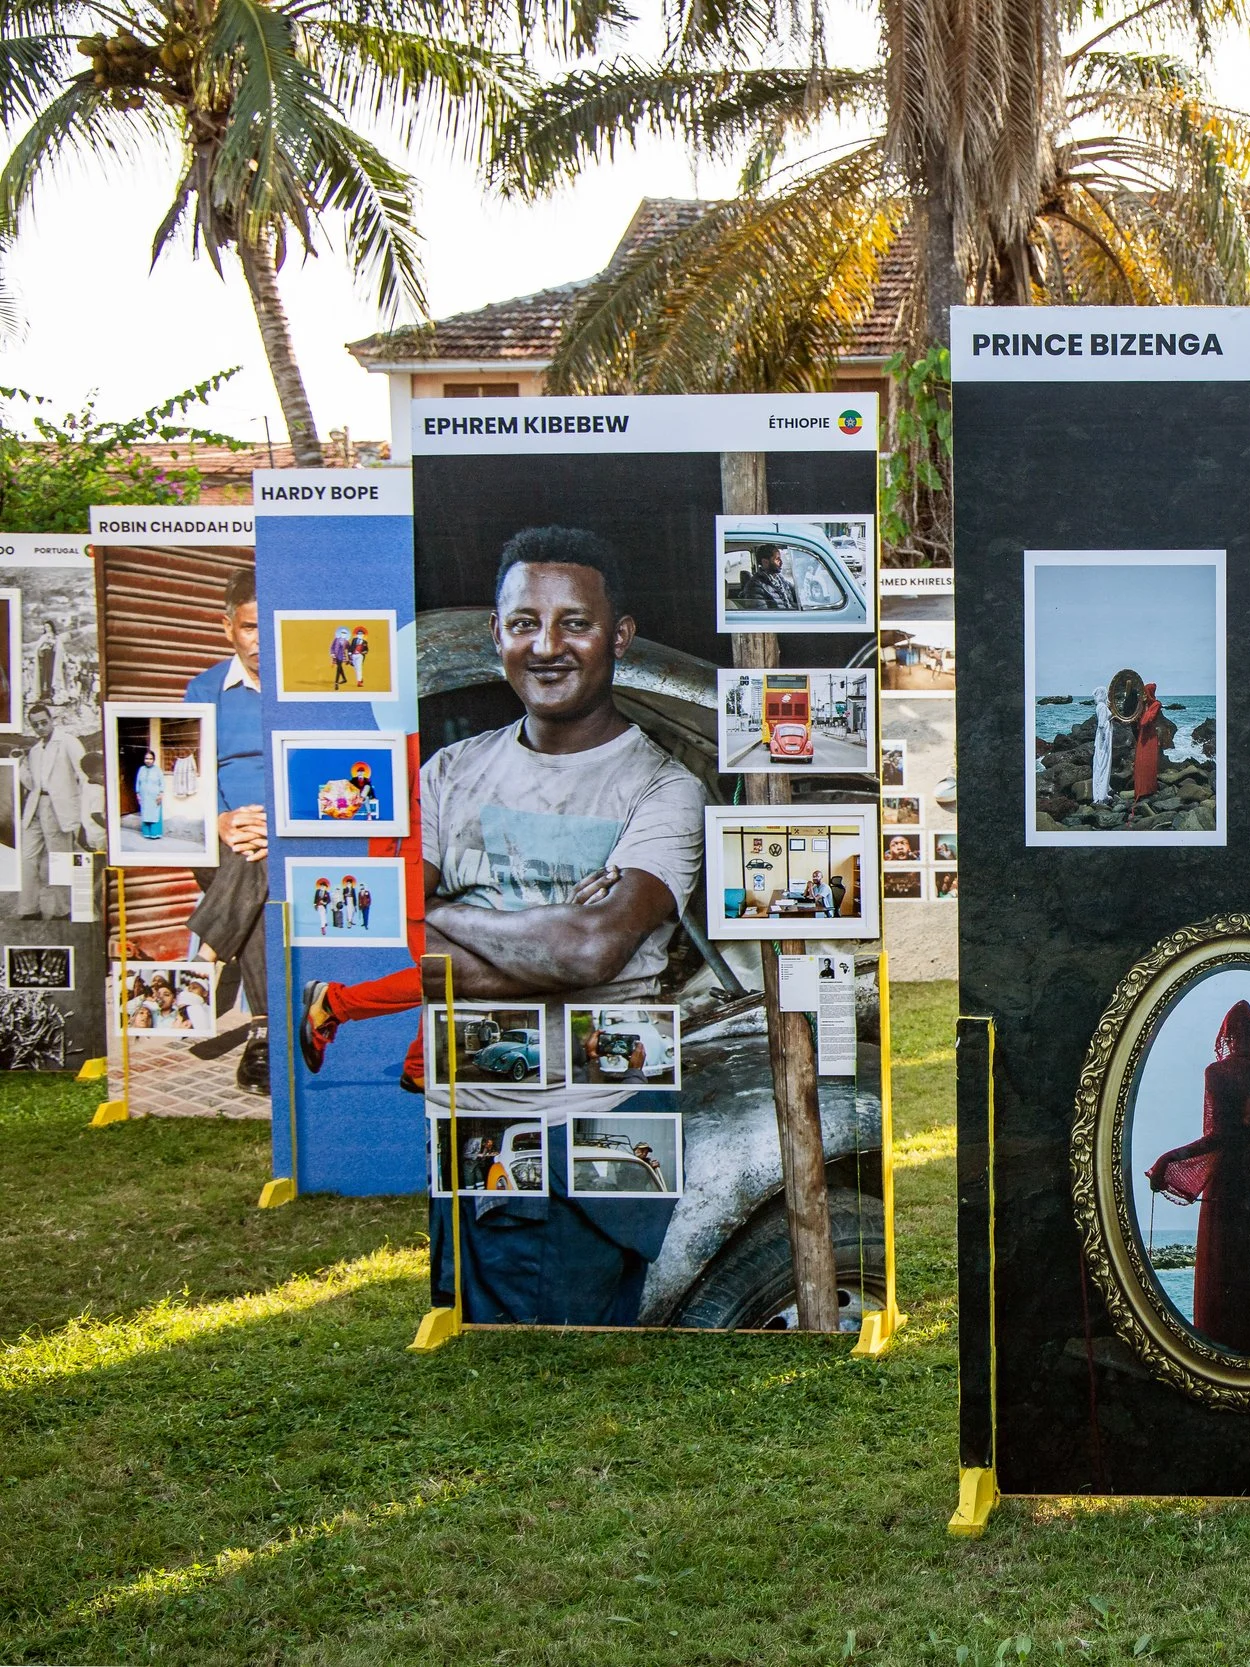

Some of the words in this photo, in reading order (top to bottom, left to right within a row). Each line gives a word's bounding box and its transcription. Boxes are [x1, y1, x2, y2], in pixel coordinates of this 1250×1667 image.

[972, 333, 1083, 356] PRINCE
[1090, 333, 1224, 356] BIZENGA
[424, 416, 518, 435] EPHREM
[523, 415, 630, 434] KIBEBEW
[768, 414, 830, 429] ÉTHIOPIE
[261, 486, 327, 500] HARDY
[330, 485, 379, 500] BOPE
[99, 521, 147, 533] ROBIN
[150, 521, 229, 533] CHADDAH
[34, 547, 79, 555] PORTUGAL
